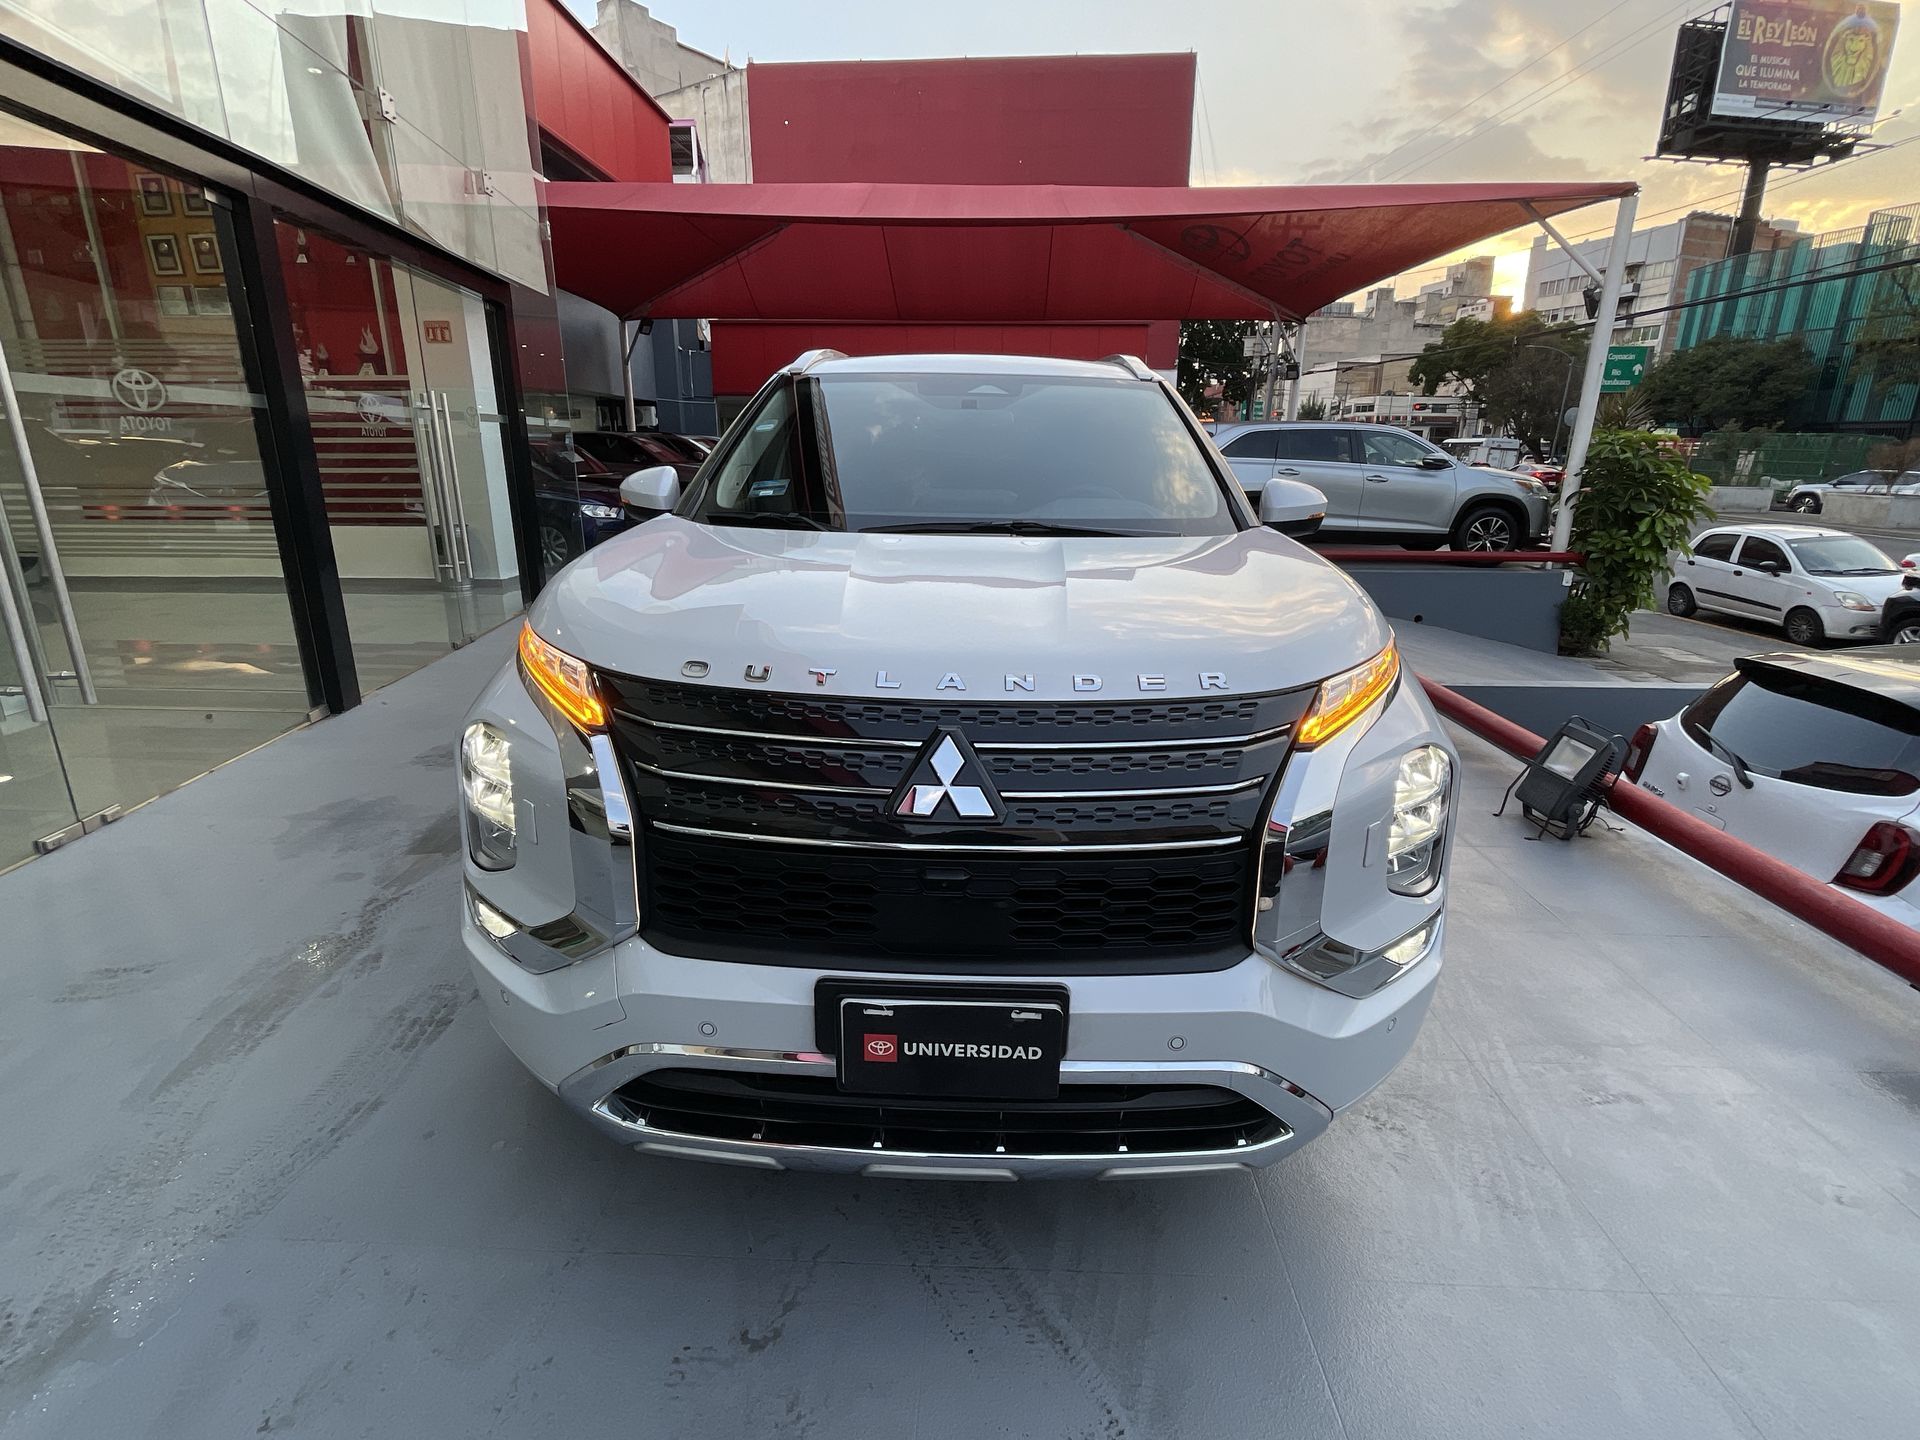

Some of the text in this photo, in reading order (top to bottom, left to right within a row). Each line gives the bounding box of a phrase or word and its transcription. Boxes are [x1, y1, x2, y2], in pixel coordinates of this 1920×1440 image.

[1738, 15, 1817, 47] EL REY LEÓN
[1760, 56, 1791, 66] MUSICAL
[1735, 64, 1800, 81] QUE ILUMINA
[1738, 80, 1791, 92] LA TEMPORADA
[681, 659, 1229, 692] OUTLANDER
[903, 1042, 1043, 1061] UNIVERSIDAD
